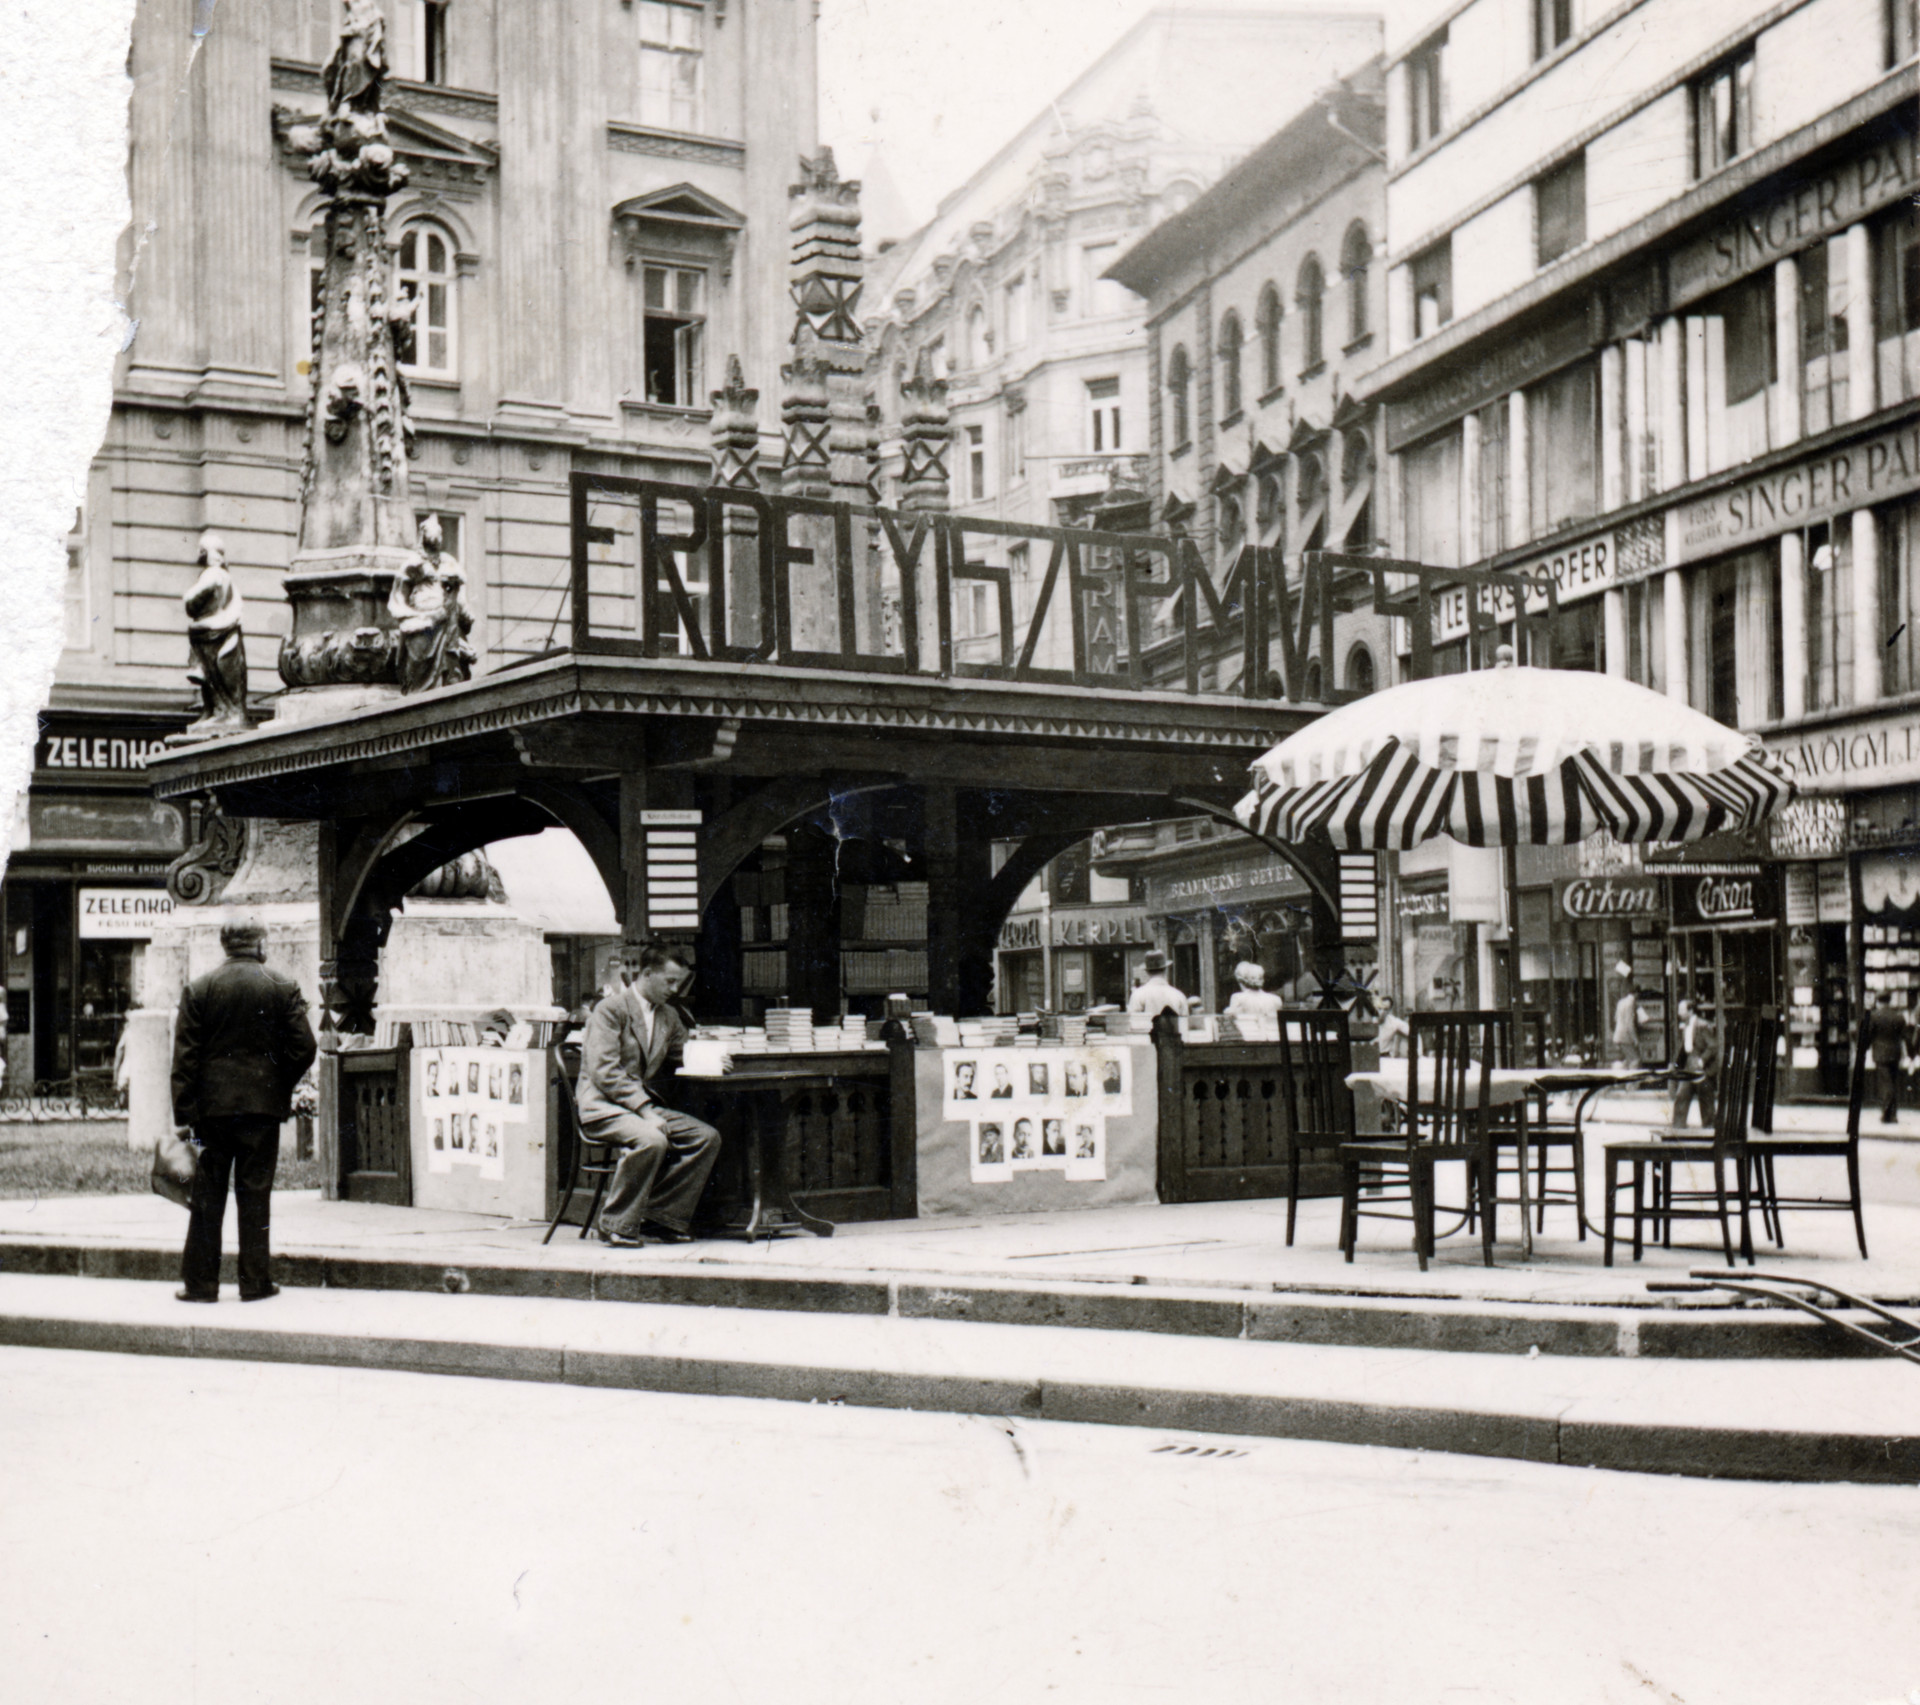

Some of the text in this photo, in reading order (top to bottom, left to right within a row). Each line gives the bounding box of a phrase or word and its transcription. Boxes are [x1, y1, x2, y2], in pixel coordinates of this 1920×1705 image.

[1713, 176, 1839, 278] SINGER
[1728, 455, 1851, 536] SINGER
[1562, 878, 1660, 918] Cirkon
[1695, 876, 1754, 919] Cirkon
[1060, 915, 1148, 945] KERPEL
